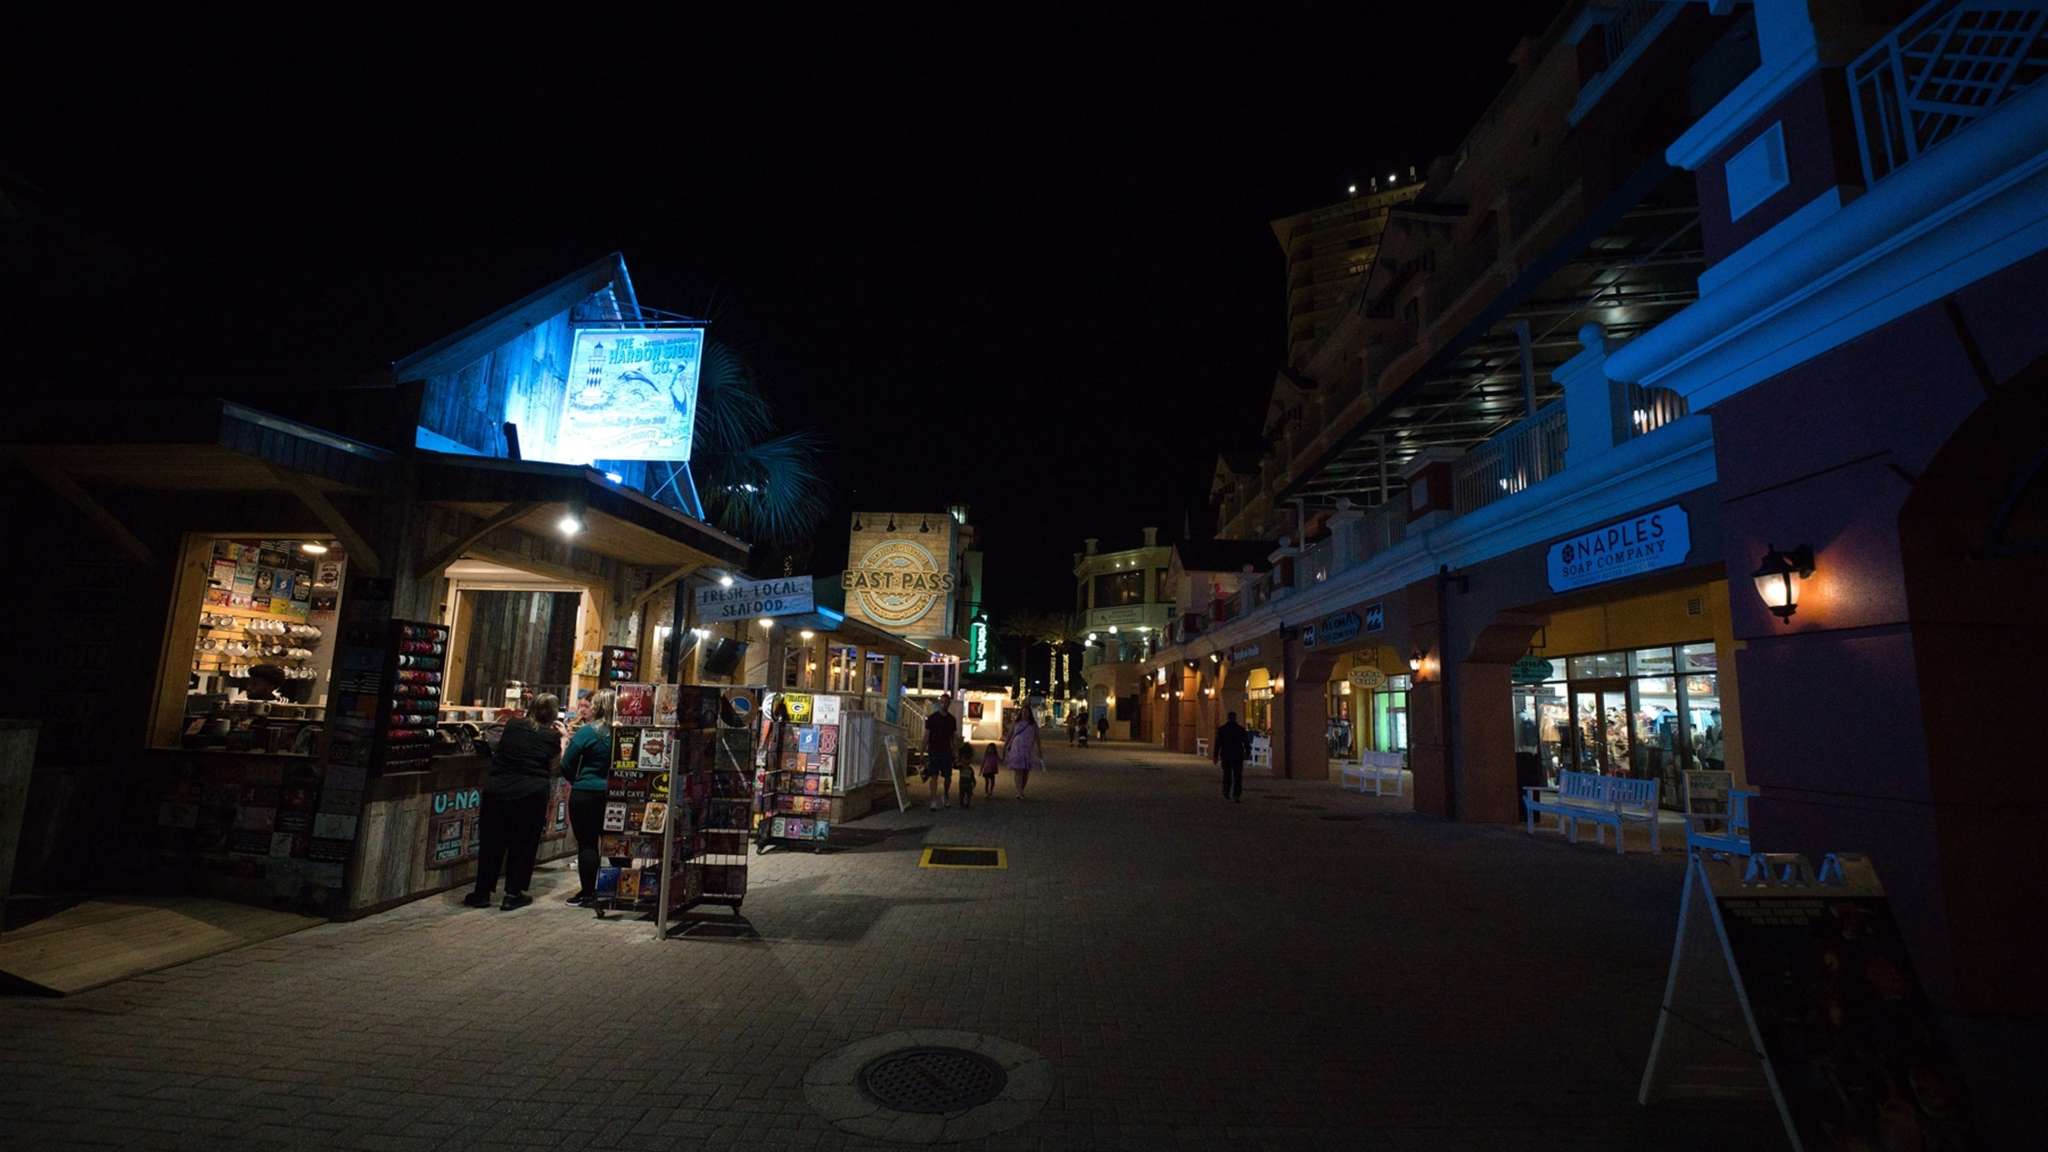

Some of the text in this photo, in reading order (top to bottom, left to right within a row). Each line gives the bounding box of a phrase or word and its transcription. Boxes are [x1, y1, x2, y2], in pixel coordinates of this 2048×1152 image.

[615, 337, 635, 350] THE
[608, 346, 661, 364] HARBOR
[1577, 514, 1665, 560] NAPLES
[1562, 559, 1593, 577] SOAP
[1597, 540, 1666, 569] COMPANY
[843, 571, 954, 591] EAST PASS
